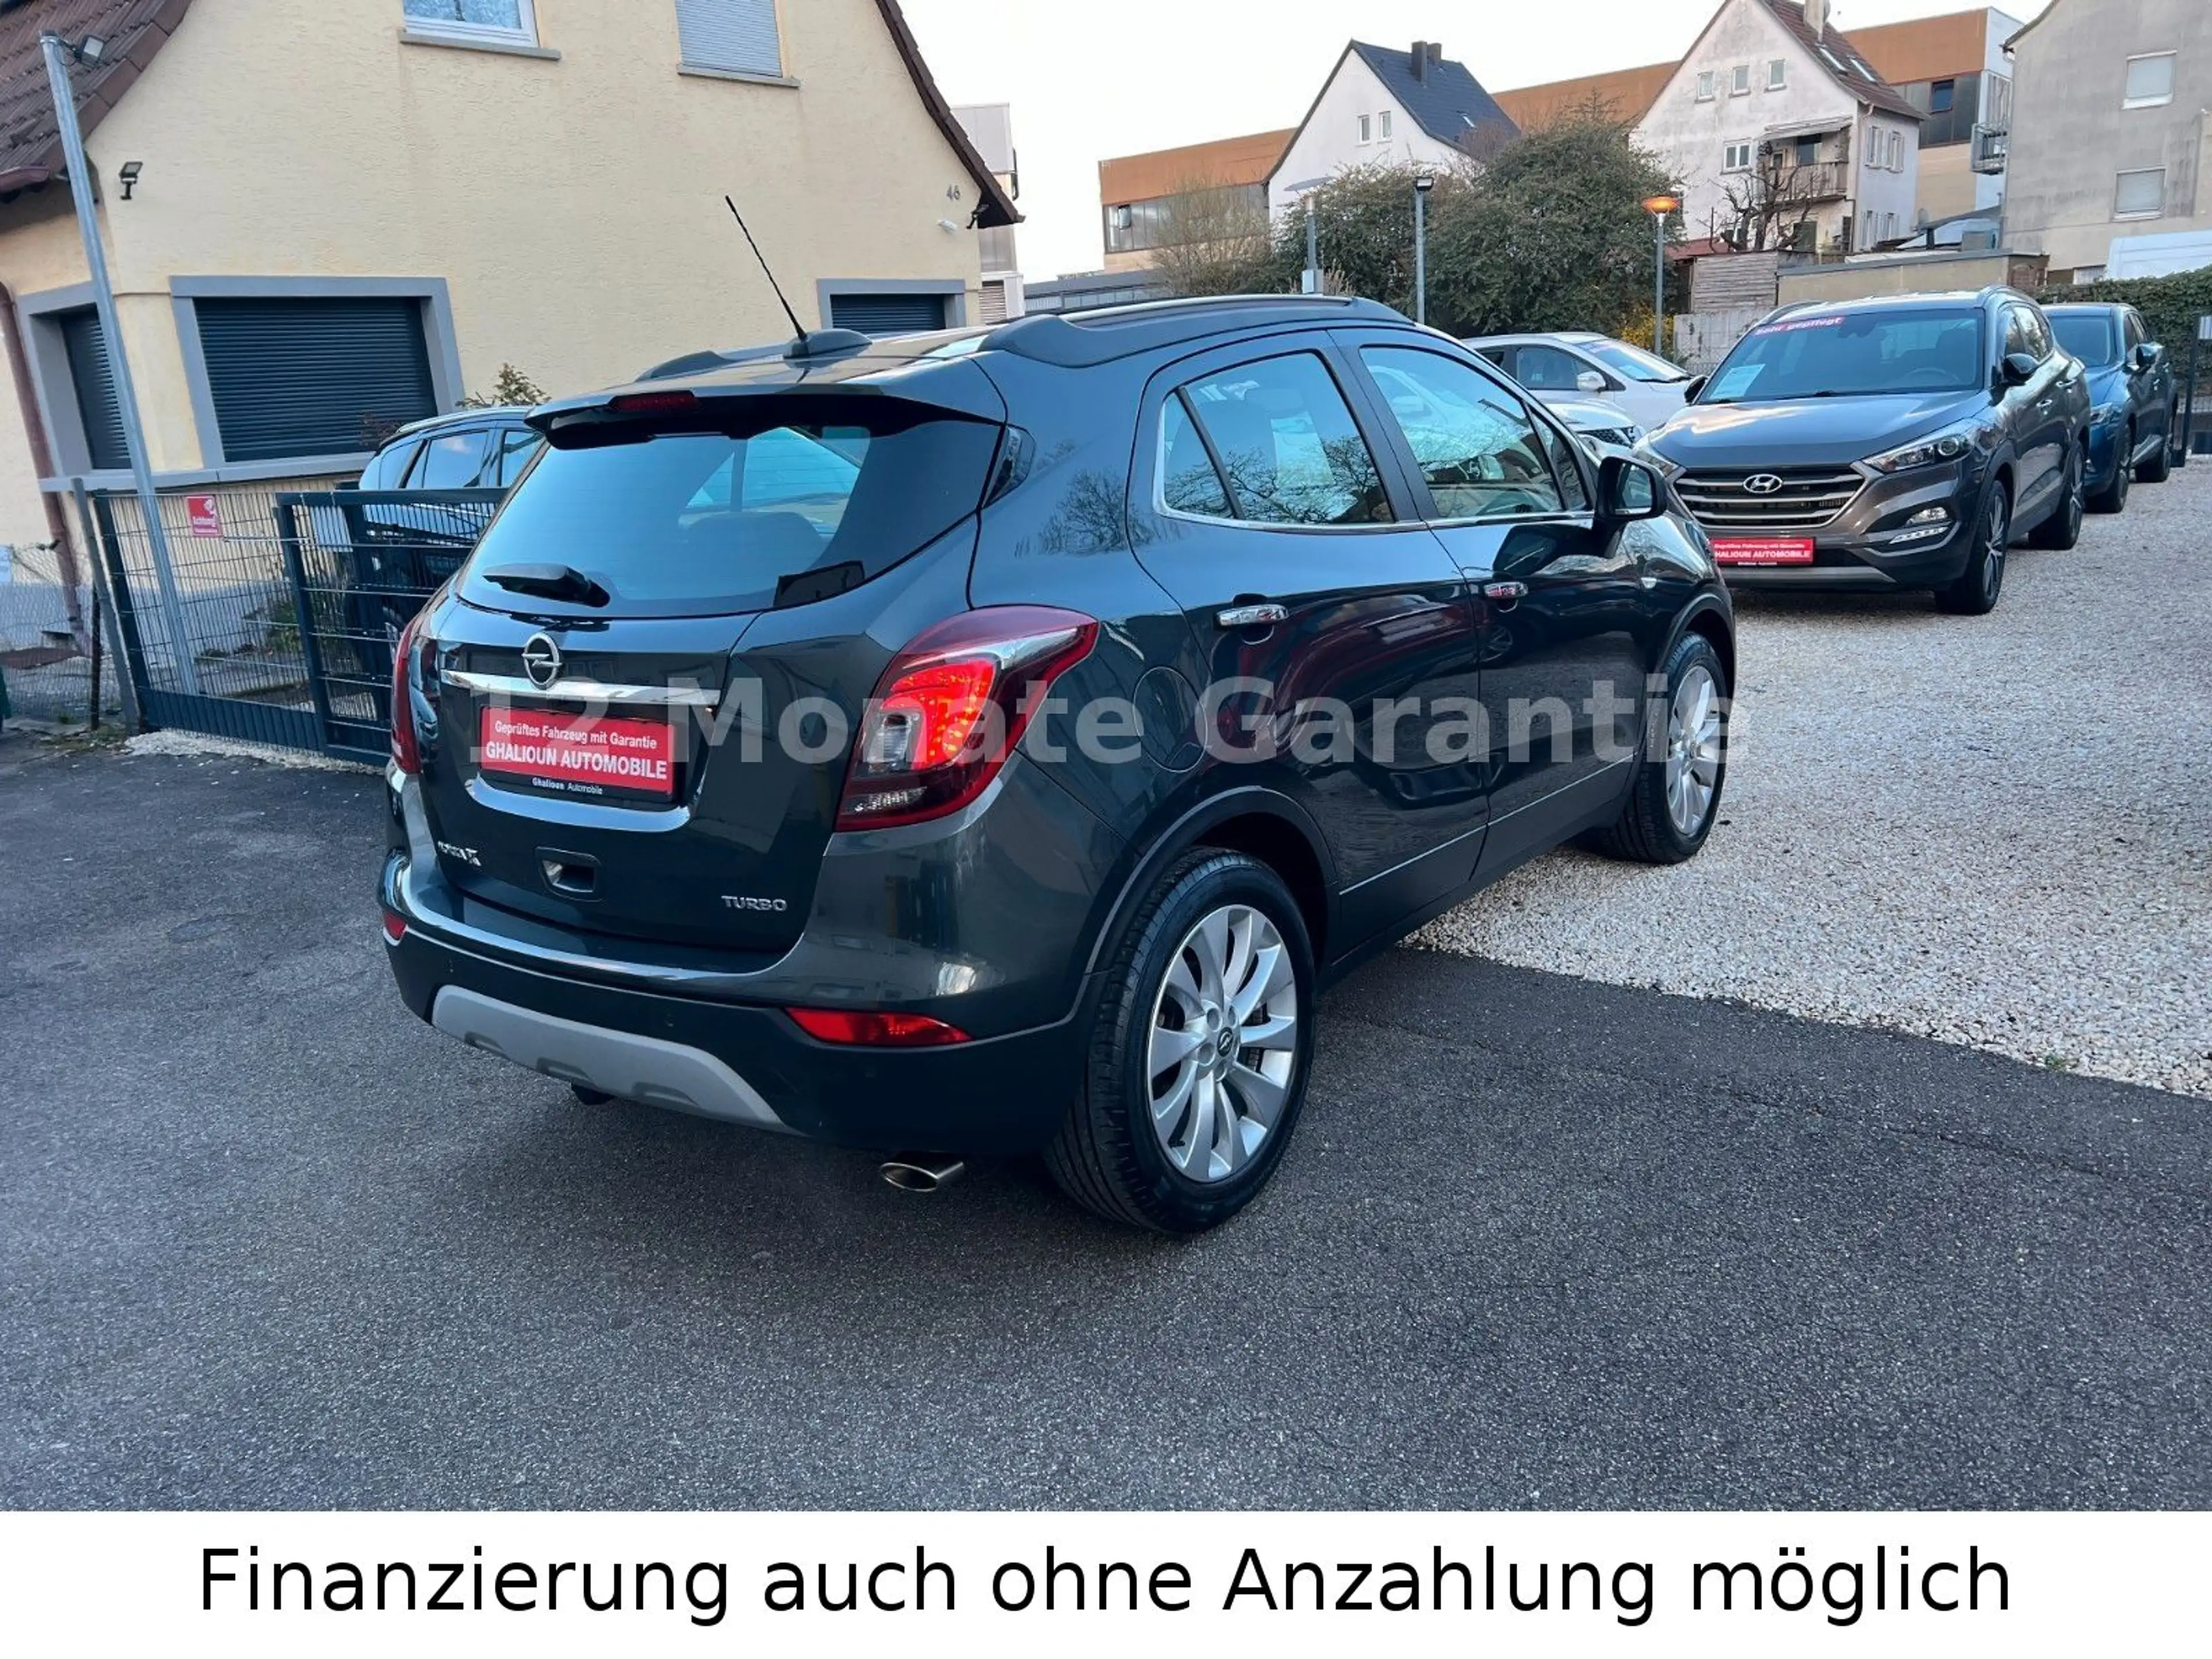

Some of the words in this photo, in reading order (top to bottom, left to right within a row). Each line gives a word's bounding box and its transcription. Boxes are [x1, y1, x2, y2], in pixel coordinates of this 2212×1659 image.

[946, 184, 961, 202] 46
[494, 720, 540, 737] Geprüftes
[542, 725, 588, 744] Fahrzeug
[590, 732, 608, 745] mit
[609, 733, 657, 749] Garantie
[486, 741, 556, 766] GHALIOUN
[560, 749, 668, 780] AUTOMOBILE
[567, 781, 603, 796] Automobile
[721, 896, 787, 911] TURBO
